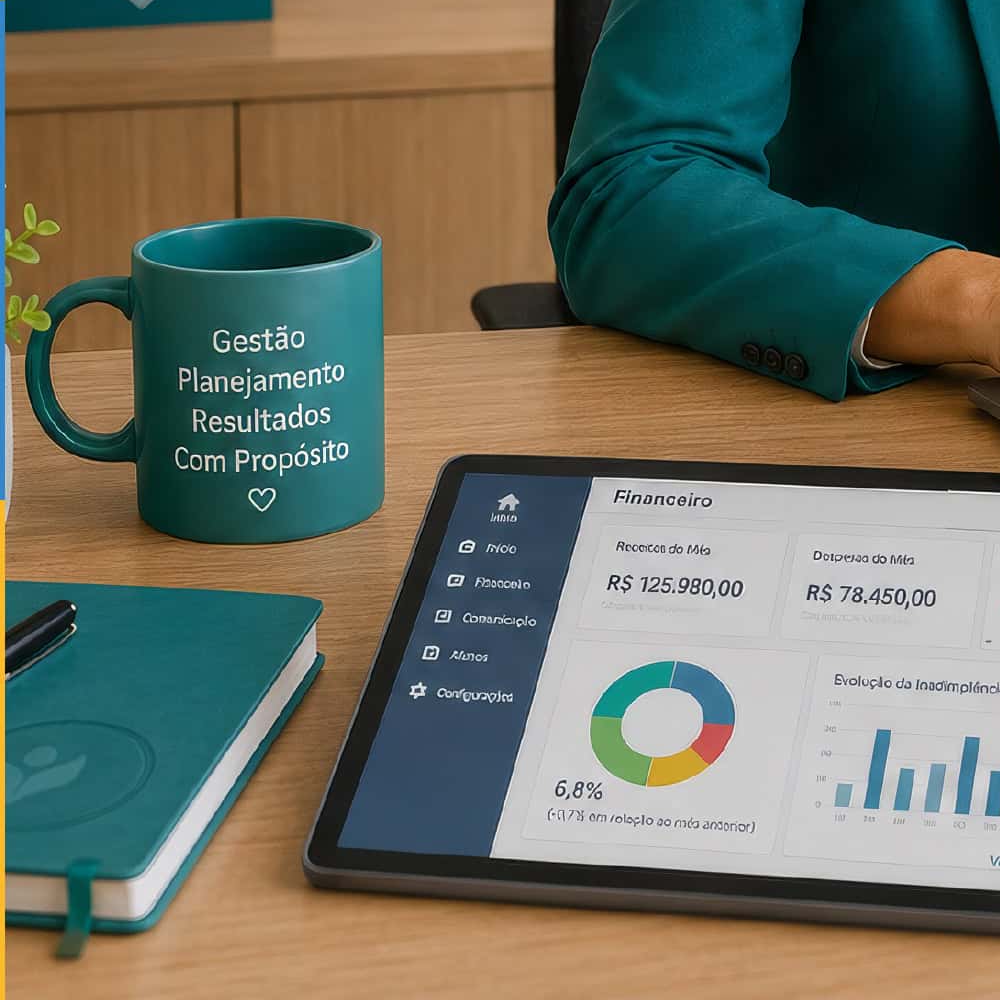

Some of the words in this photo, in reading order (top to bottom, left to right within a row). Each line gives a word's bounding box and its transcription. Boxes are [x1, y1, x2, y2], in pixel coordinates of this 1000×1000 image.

[212, 325, 305, 353] Gestão
[178, 362, 345, 399] Planejamento
[192, 402, 331, 433] Resultados
[174, 446, 226, 473] Com
[235, 440, 350, 477] Propósito
[613, 489, 713, 508] Financeiro
[606, 574, 634, 594] R$
[640, 576, 744, 600] 125.980,00
[806, 583, 833, 604] R$
[839, 585, 937, 610] 78.450,00
[554, 779, 603, 801] 6,8%
